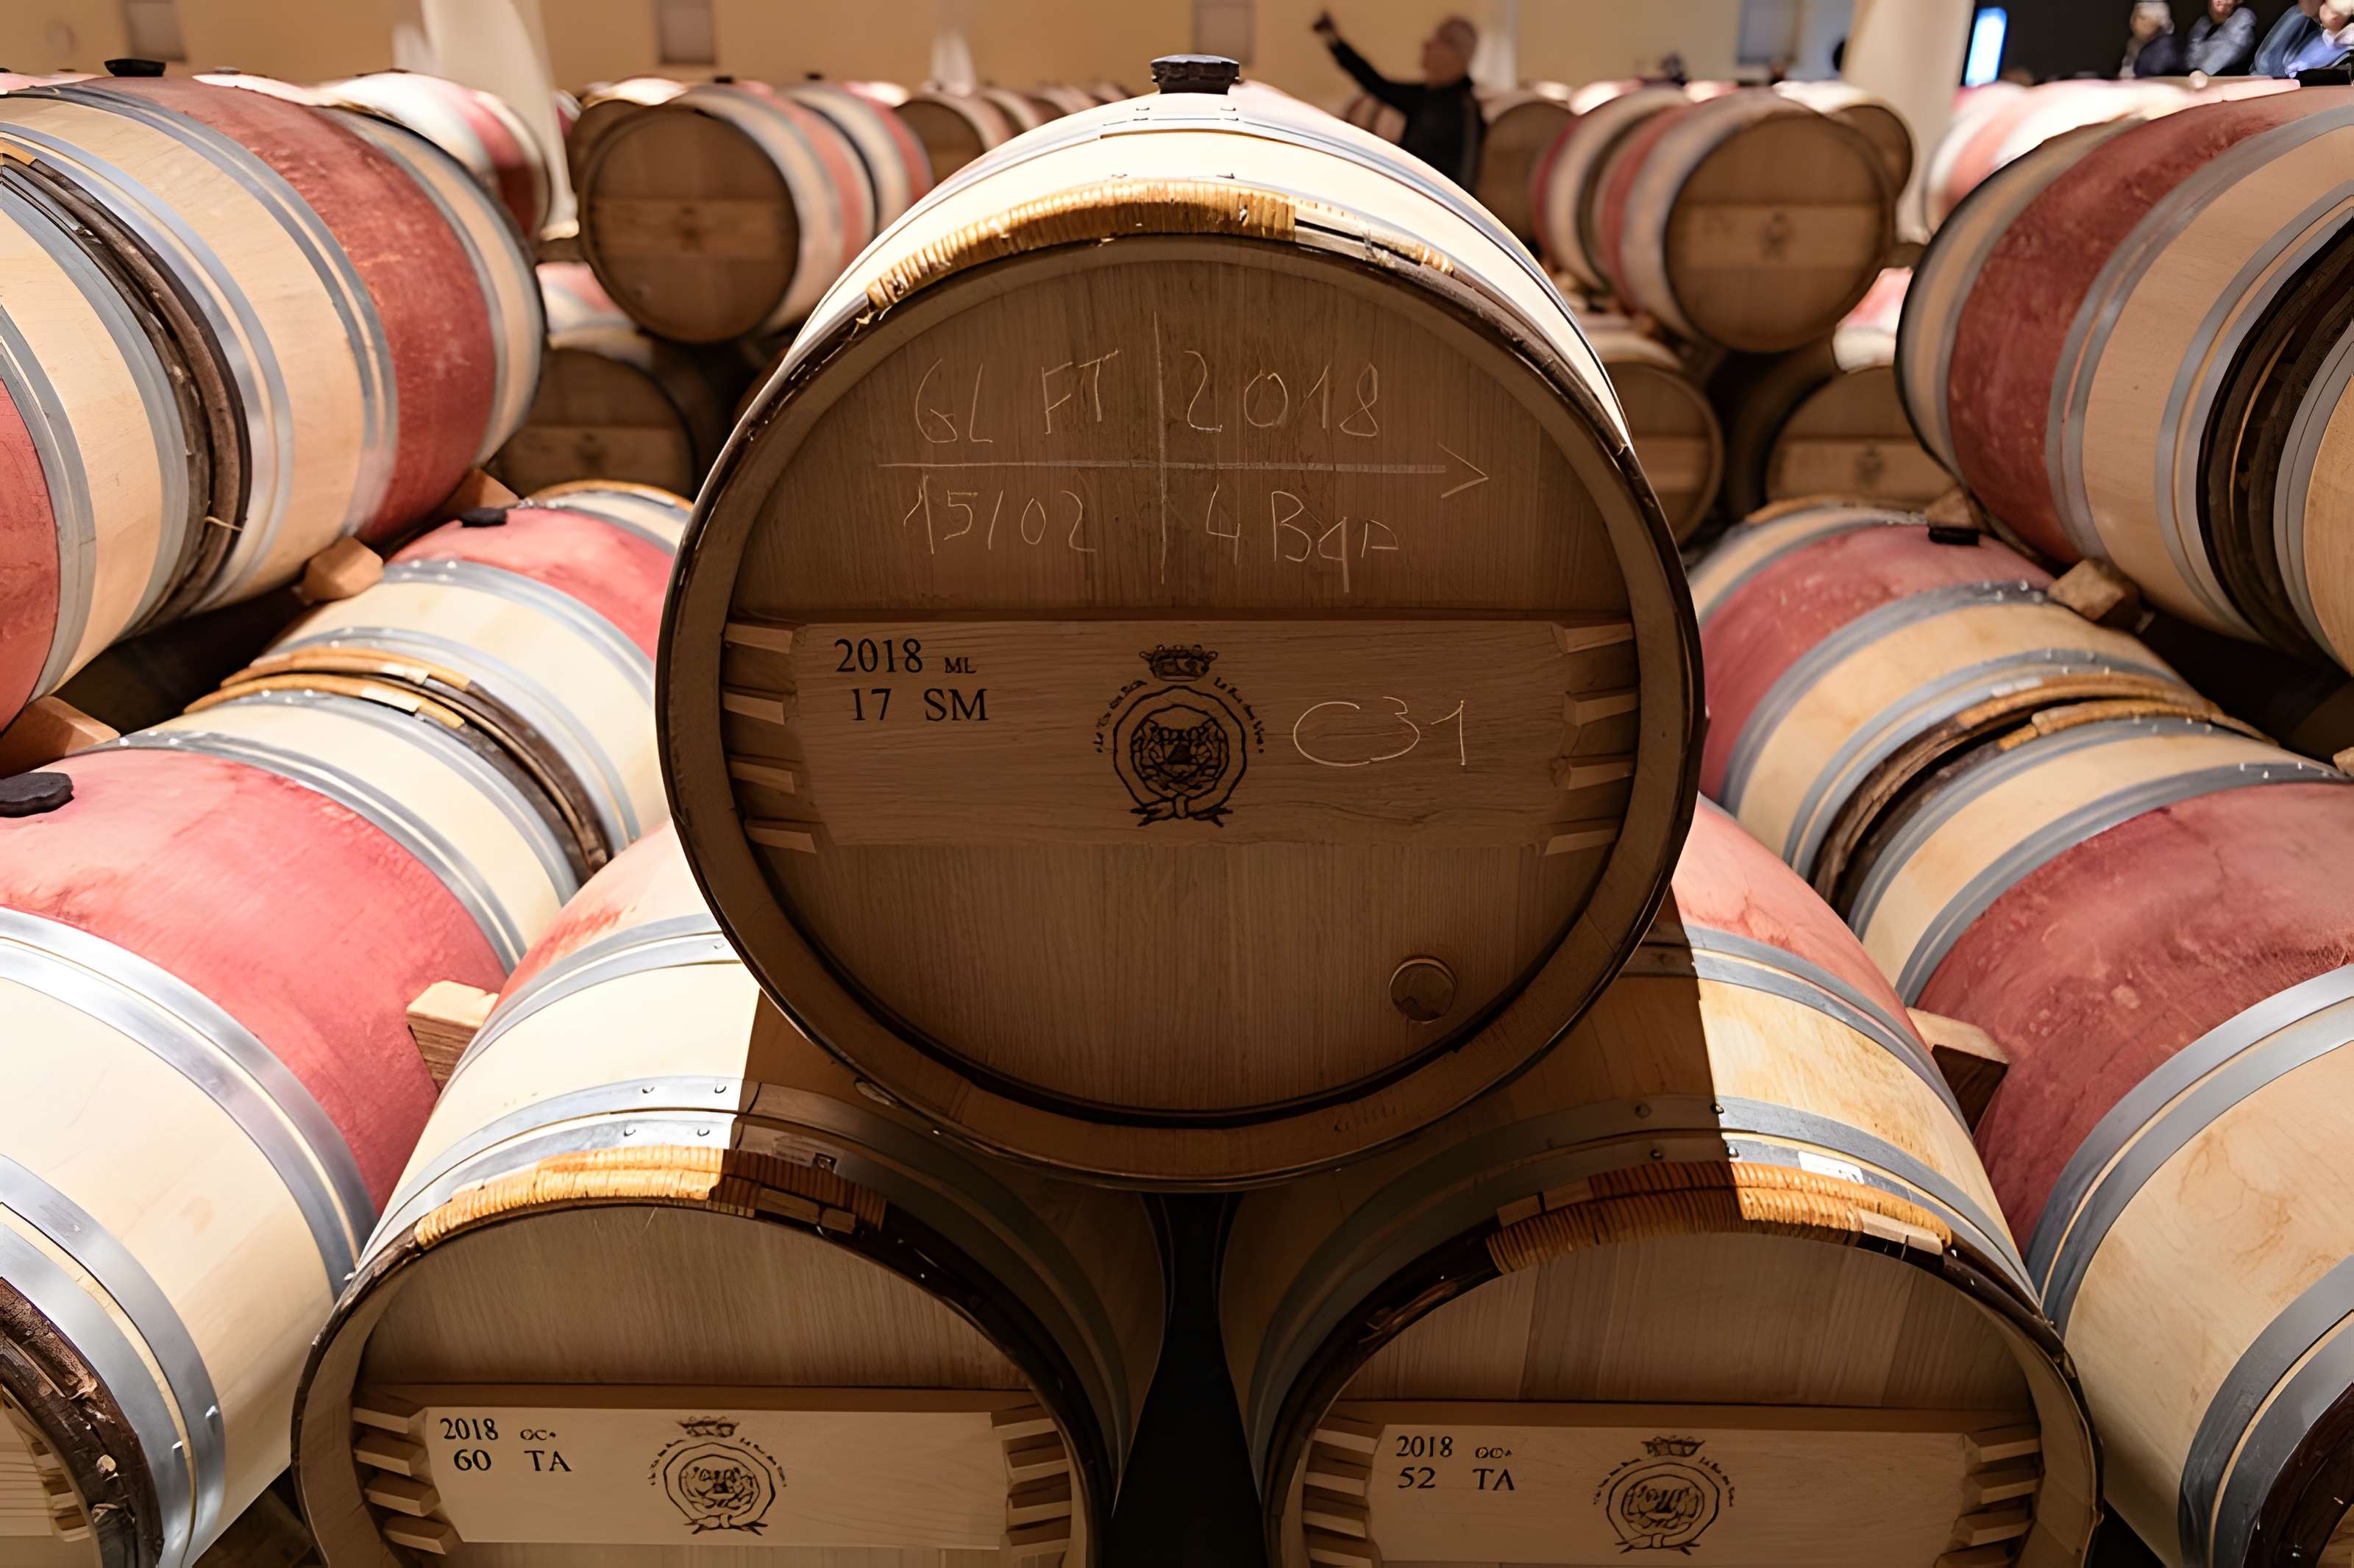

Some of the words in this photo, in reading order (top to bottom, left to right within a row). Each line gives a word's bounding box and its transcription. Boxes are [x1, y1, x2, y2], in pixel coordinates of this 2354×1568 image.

[1041, 347, 1120, 435] FT
[1184, 349, 1379, 437] 2018
[1206, 482, 1240, 565] 4
[834, 638, 924, 674] 2018
[944, 656, 978, 674] ML
[851, 688, 892, 721] 17
[923, 688, 989, 722] SM
[1292, 696, 1466, 766] C31
[440, 1417, 499, 1441] 2018
[453, 1448, 492, 1472] 60
[524, 1450, 572, 1472] TA
[1395, 1435, 1454, 1458] 2018
[1397, 1466, 1437, 1489] 52
[1472, 1467, 1515, 1491] TA
